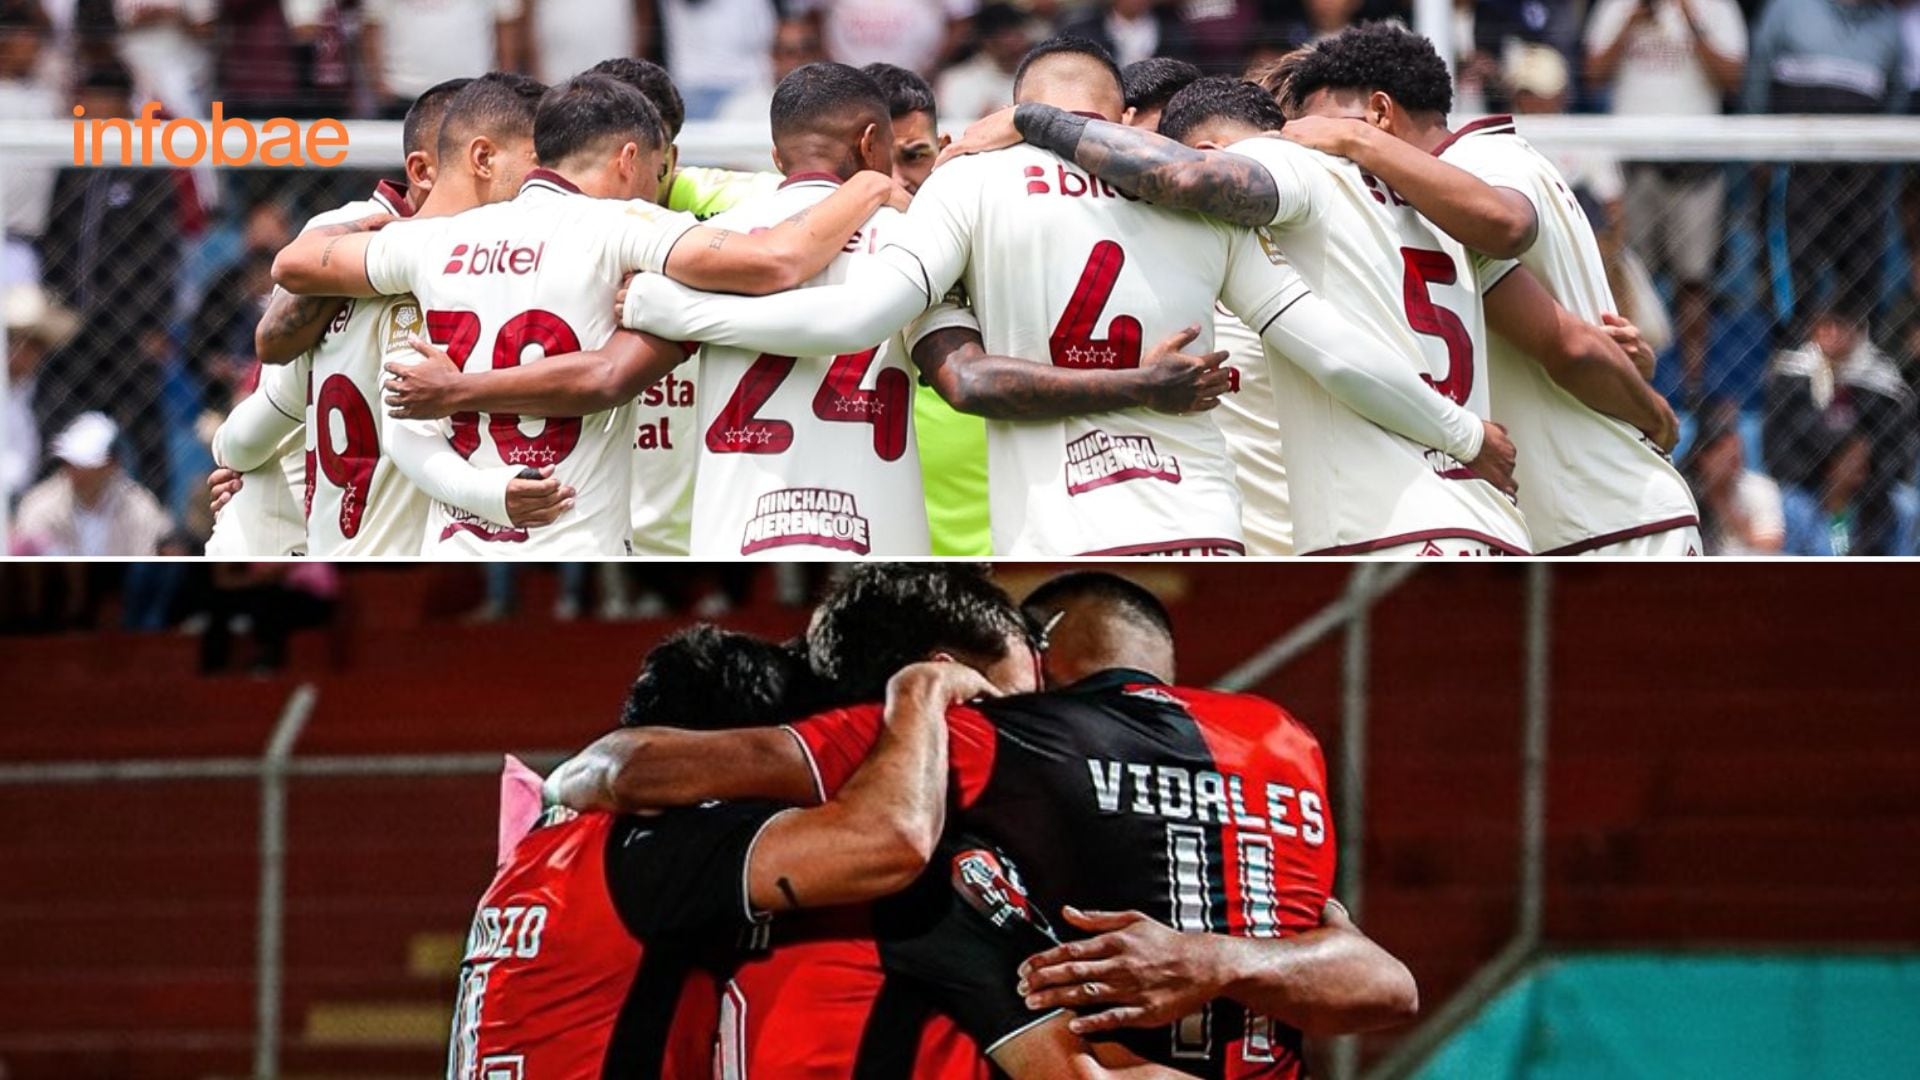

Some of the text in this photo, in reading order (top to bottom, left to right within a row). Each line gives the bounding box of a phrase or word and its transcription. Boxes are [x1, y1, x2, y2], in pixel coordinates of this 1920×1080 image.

[467, 240, 545, 275] bitel
[1049, 239, 1143, 370] 4
[1400, 246, 1474, 407] 5
[705, 342, 910, 463] 24
[757, 488, 857, 517] HINCHADA
[1087, 758, 1325, 847] VIDALES
[1167, 822, 1282, 1063] 11
